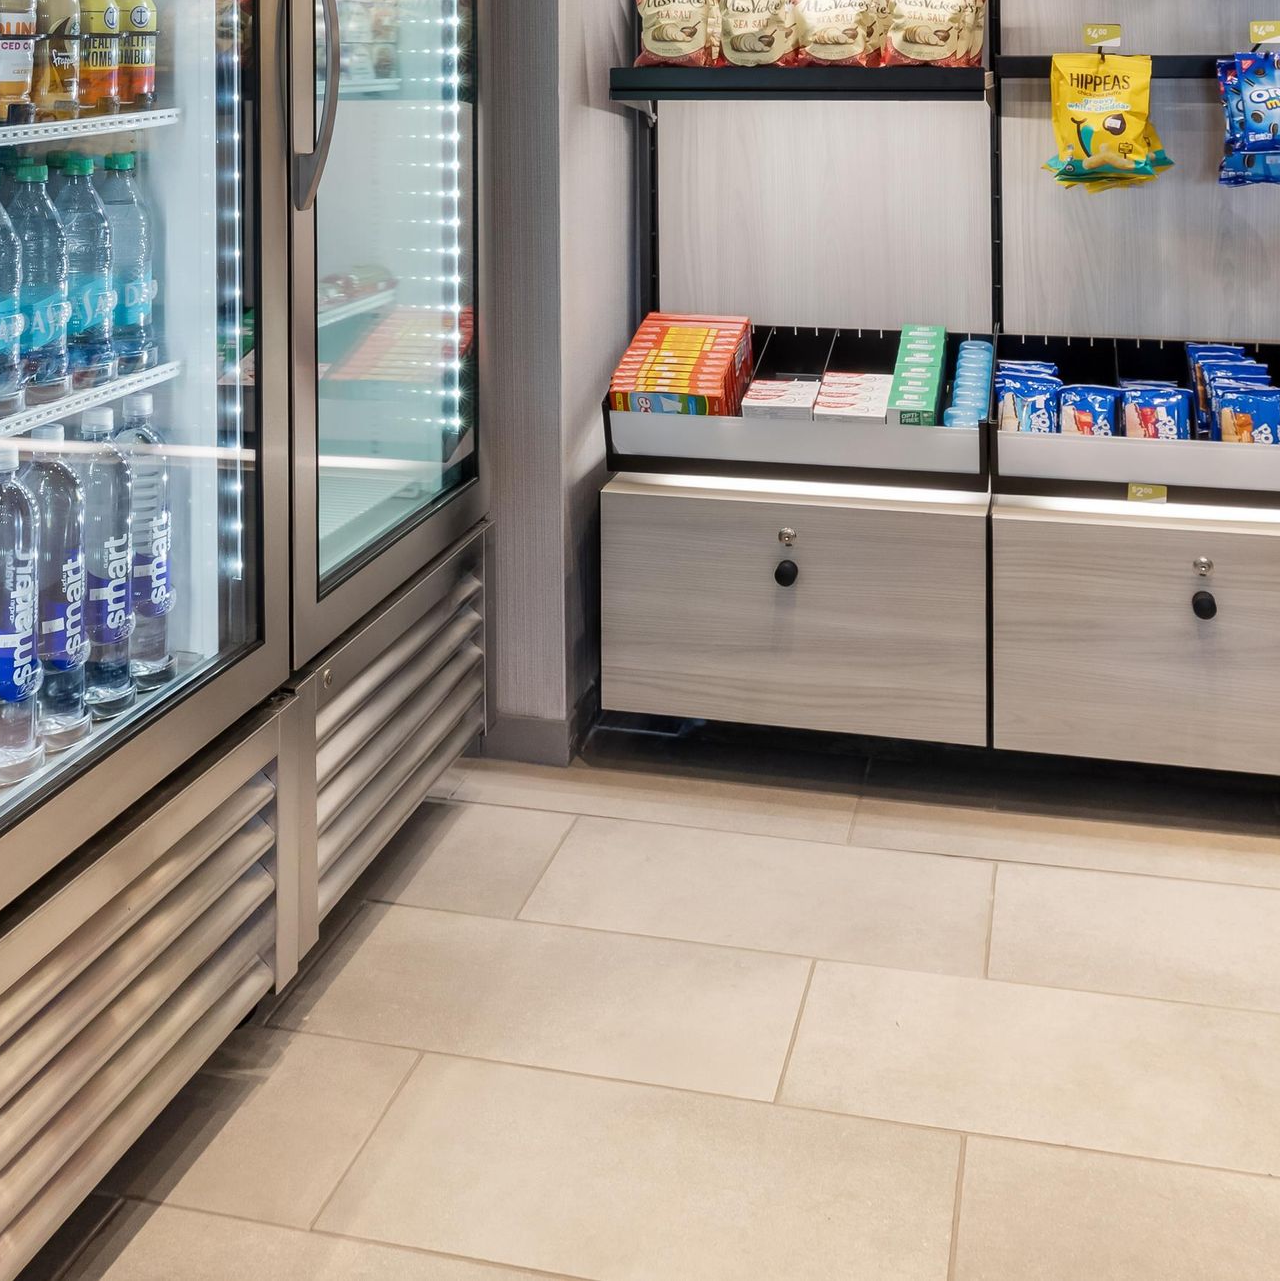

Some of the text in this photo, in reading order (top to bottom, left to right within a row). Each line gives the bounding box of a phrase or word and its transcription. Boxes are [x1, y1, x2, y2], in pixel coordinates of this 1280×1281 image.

[656, 10, 692, 19] SEA SALT
[733, 19, 748, 29] SEA
[1070, 72, 1131, 91] HIPPEAS
[1084, 97, 1114, 106] groovy
